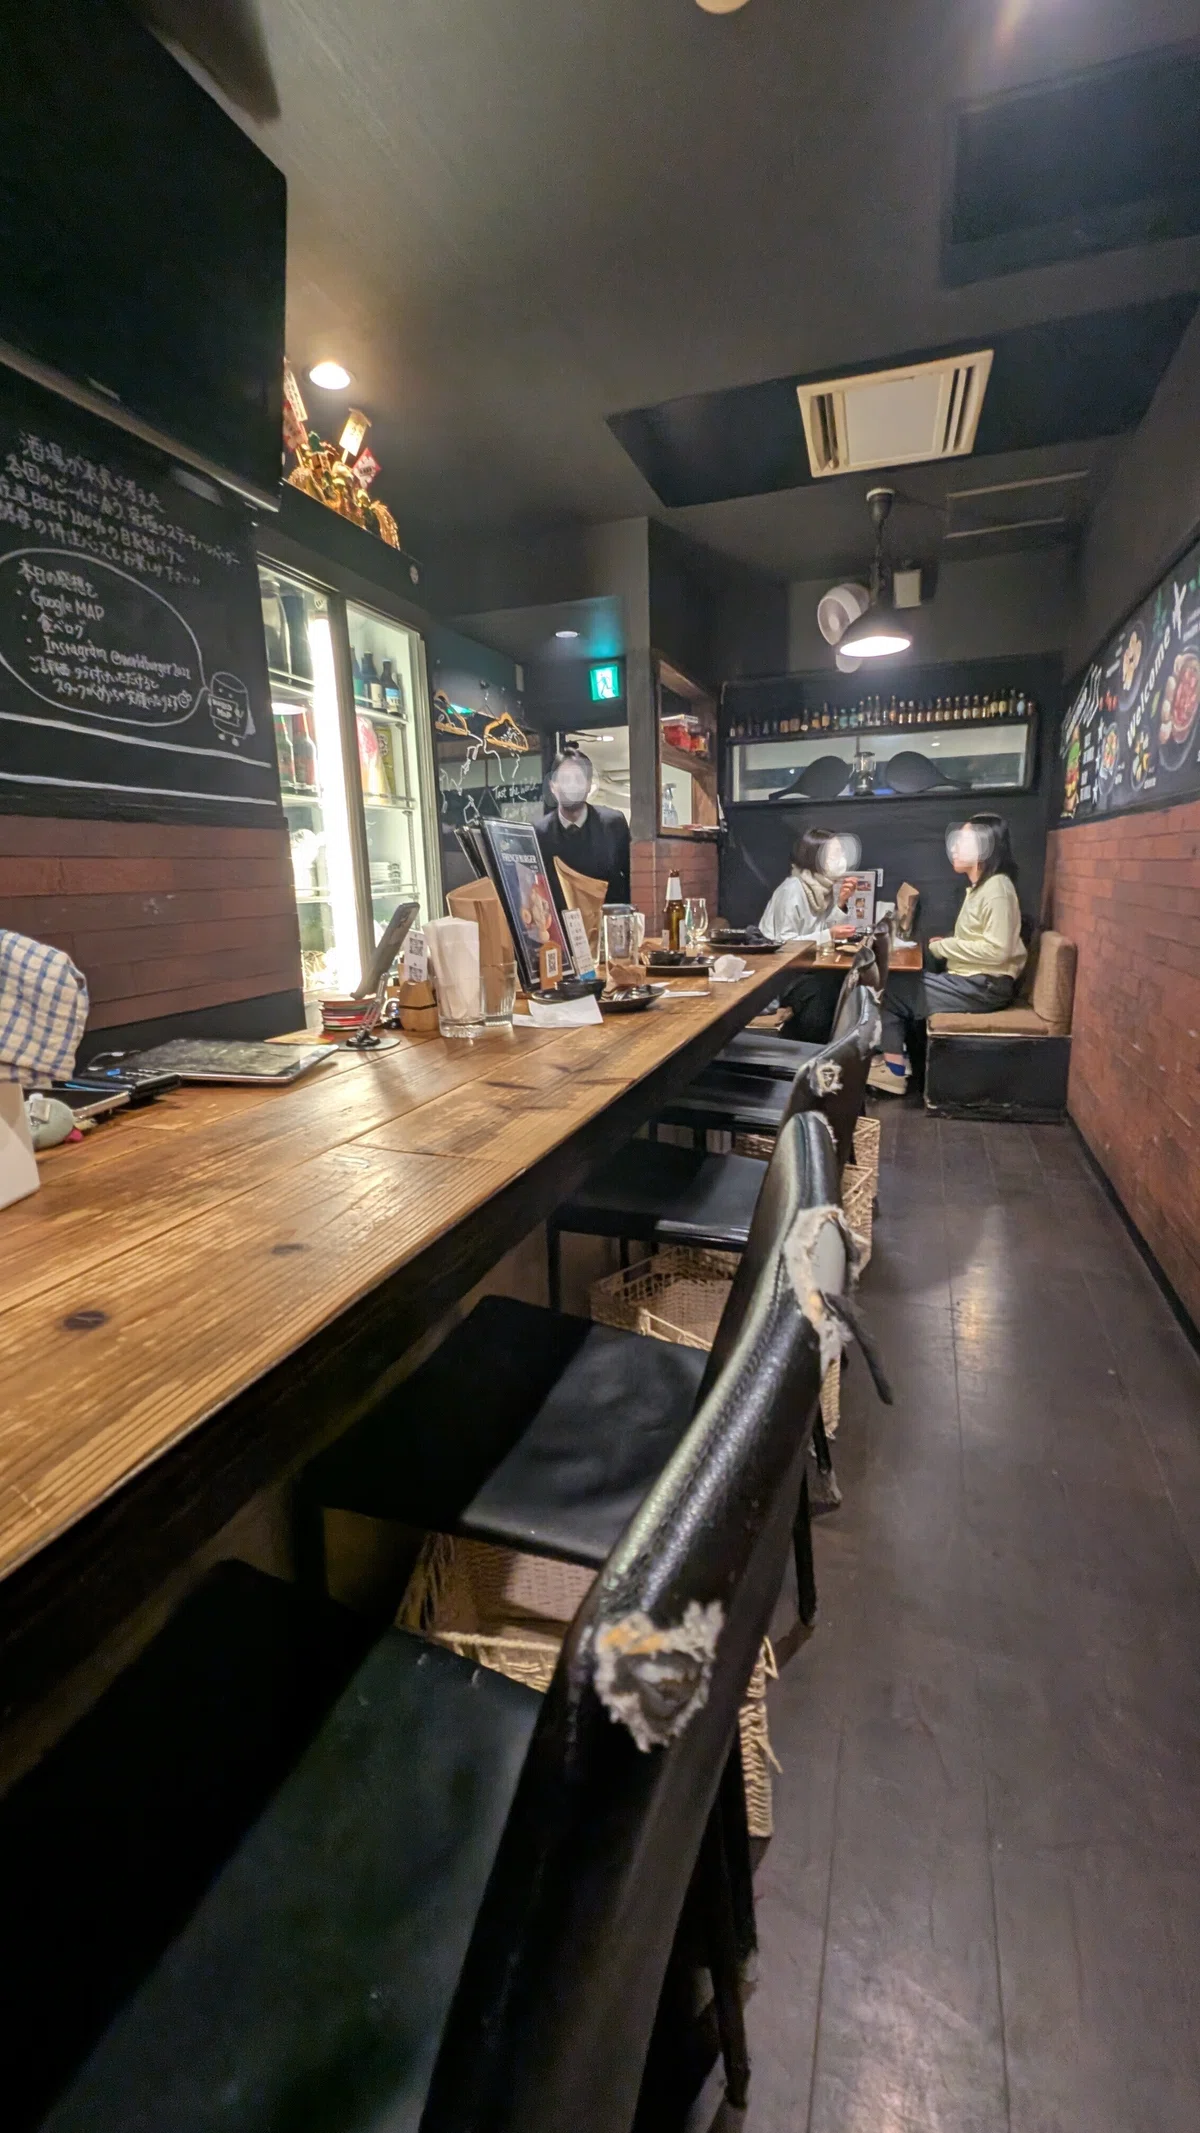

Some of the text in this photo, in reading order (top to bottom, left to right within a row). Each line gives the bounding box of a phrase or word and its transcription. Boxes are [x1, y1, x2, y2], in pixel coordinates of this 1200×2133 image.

[31, 588, 105, 621] Google MAP
[37, 612, 86, 639] 食べログ
[43, 635, 108, 663] Instagram
